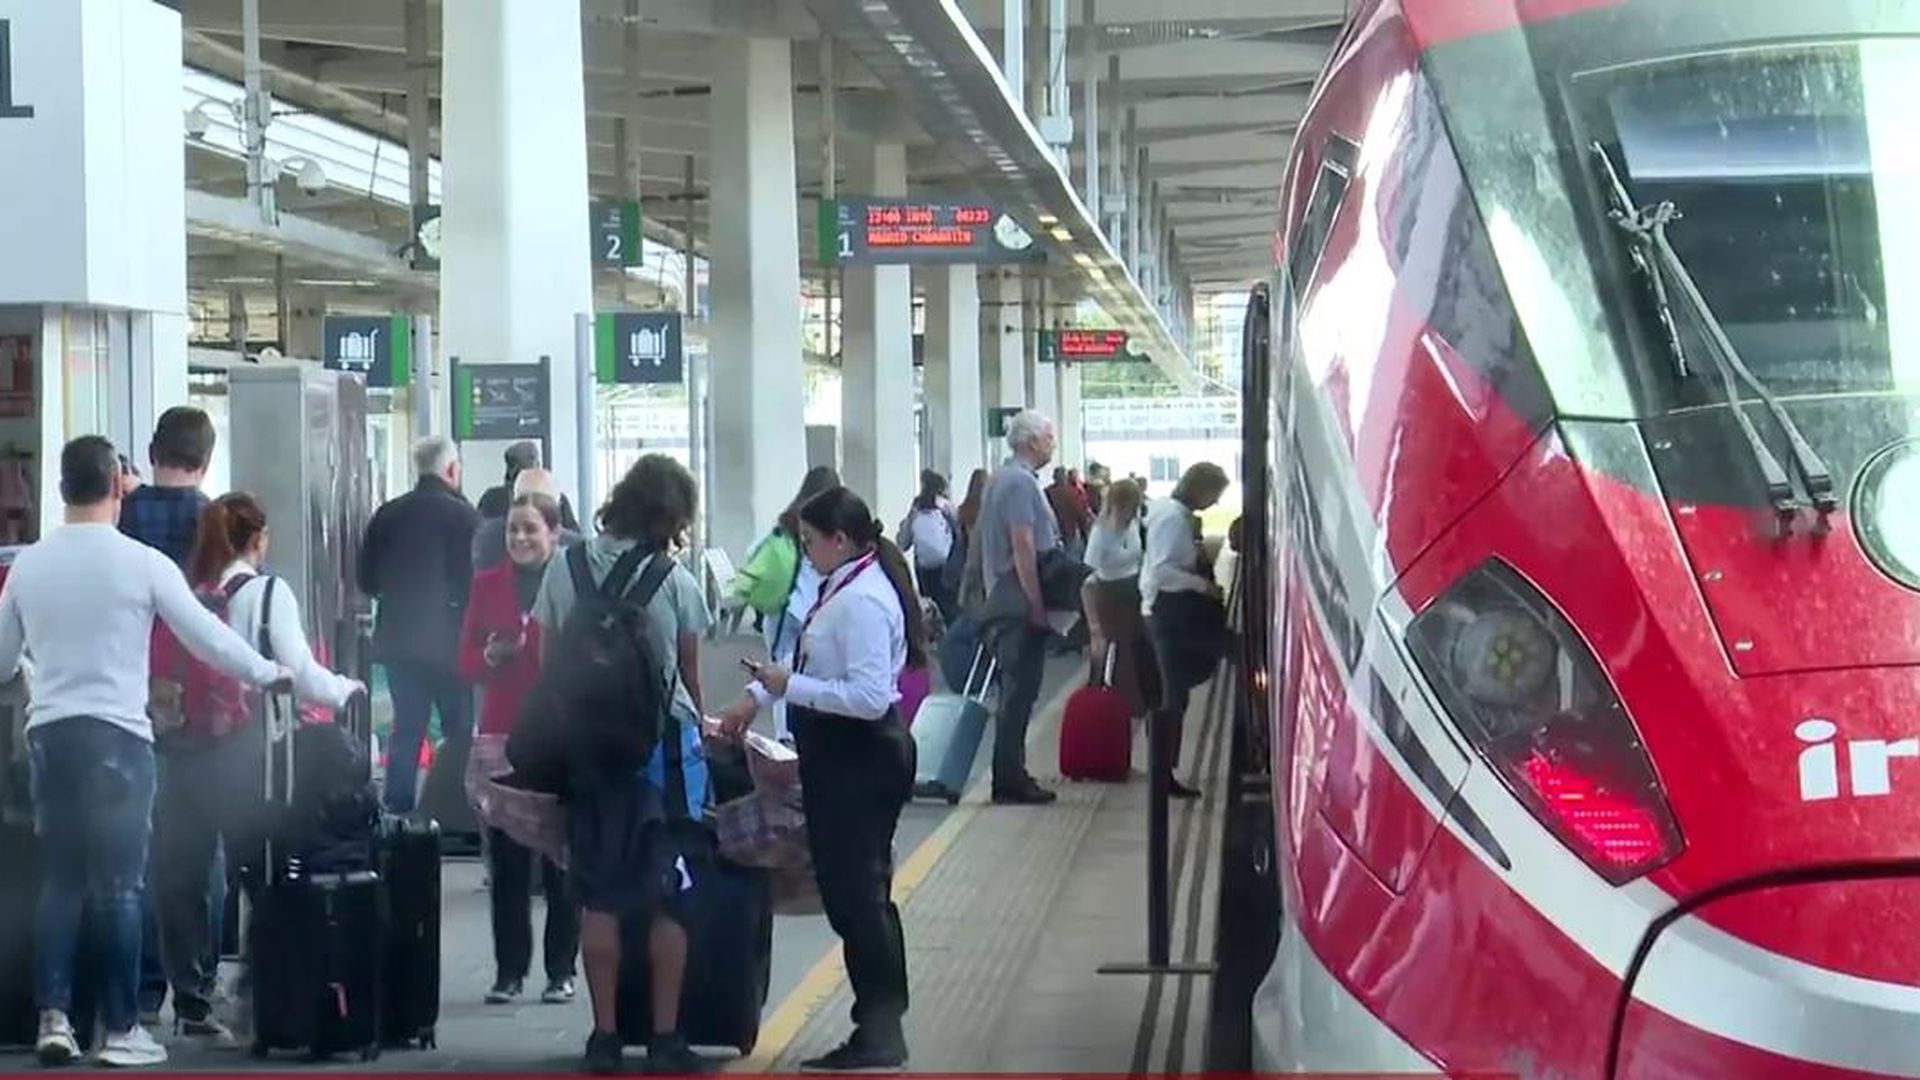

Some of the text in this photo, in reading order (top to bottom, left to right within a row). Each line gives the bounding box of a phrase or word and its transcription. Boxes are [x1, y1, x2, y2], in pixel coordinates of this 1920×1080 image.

[606, 235, 621, 259] 2
[838, 232, 854, 257] 1
[868, 231, 908, 243] MADRID
